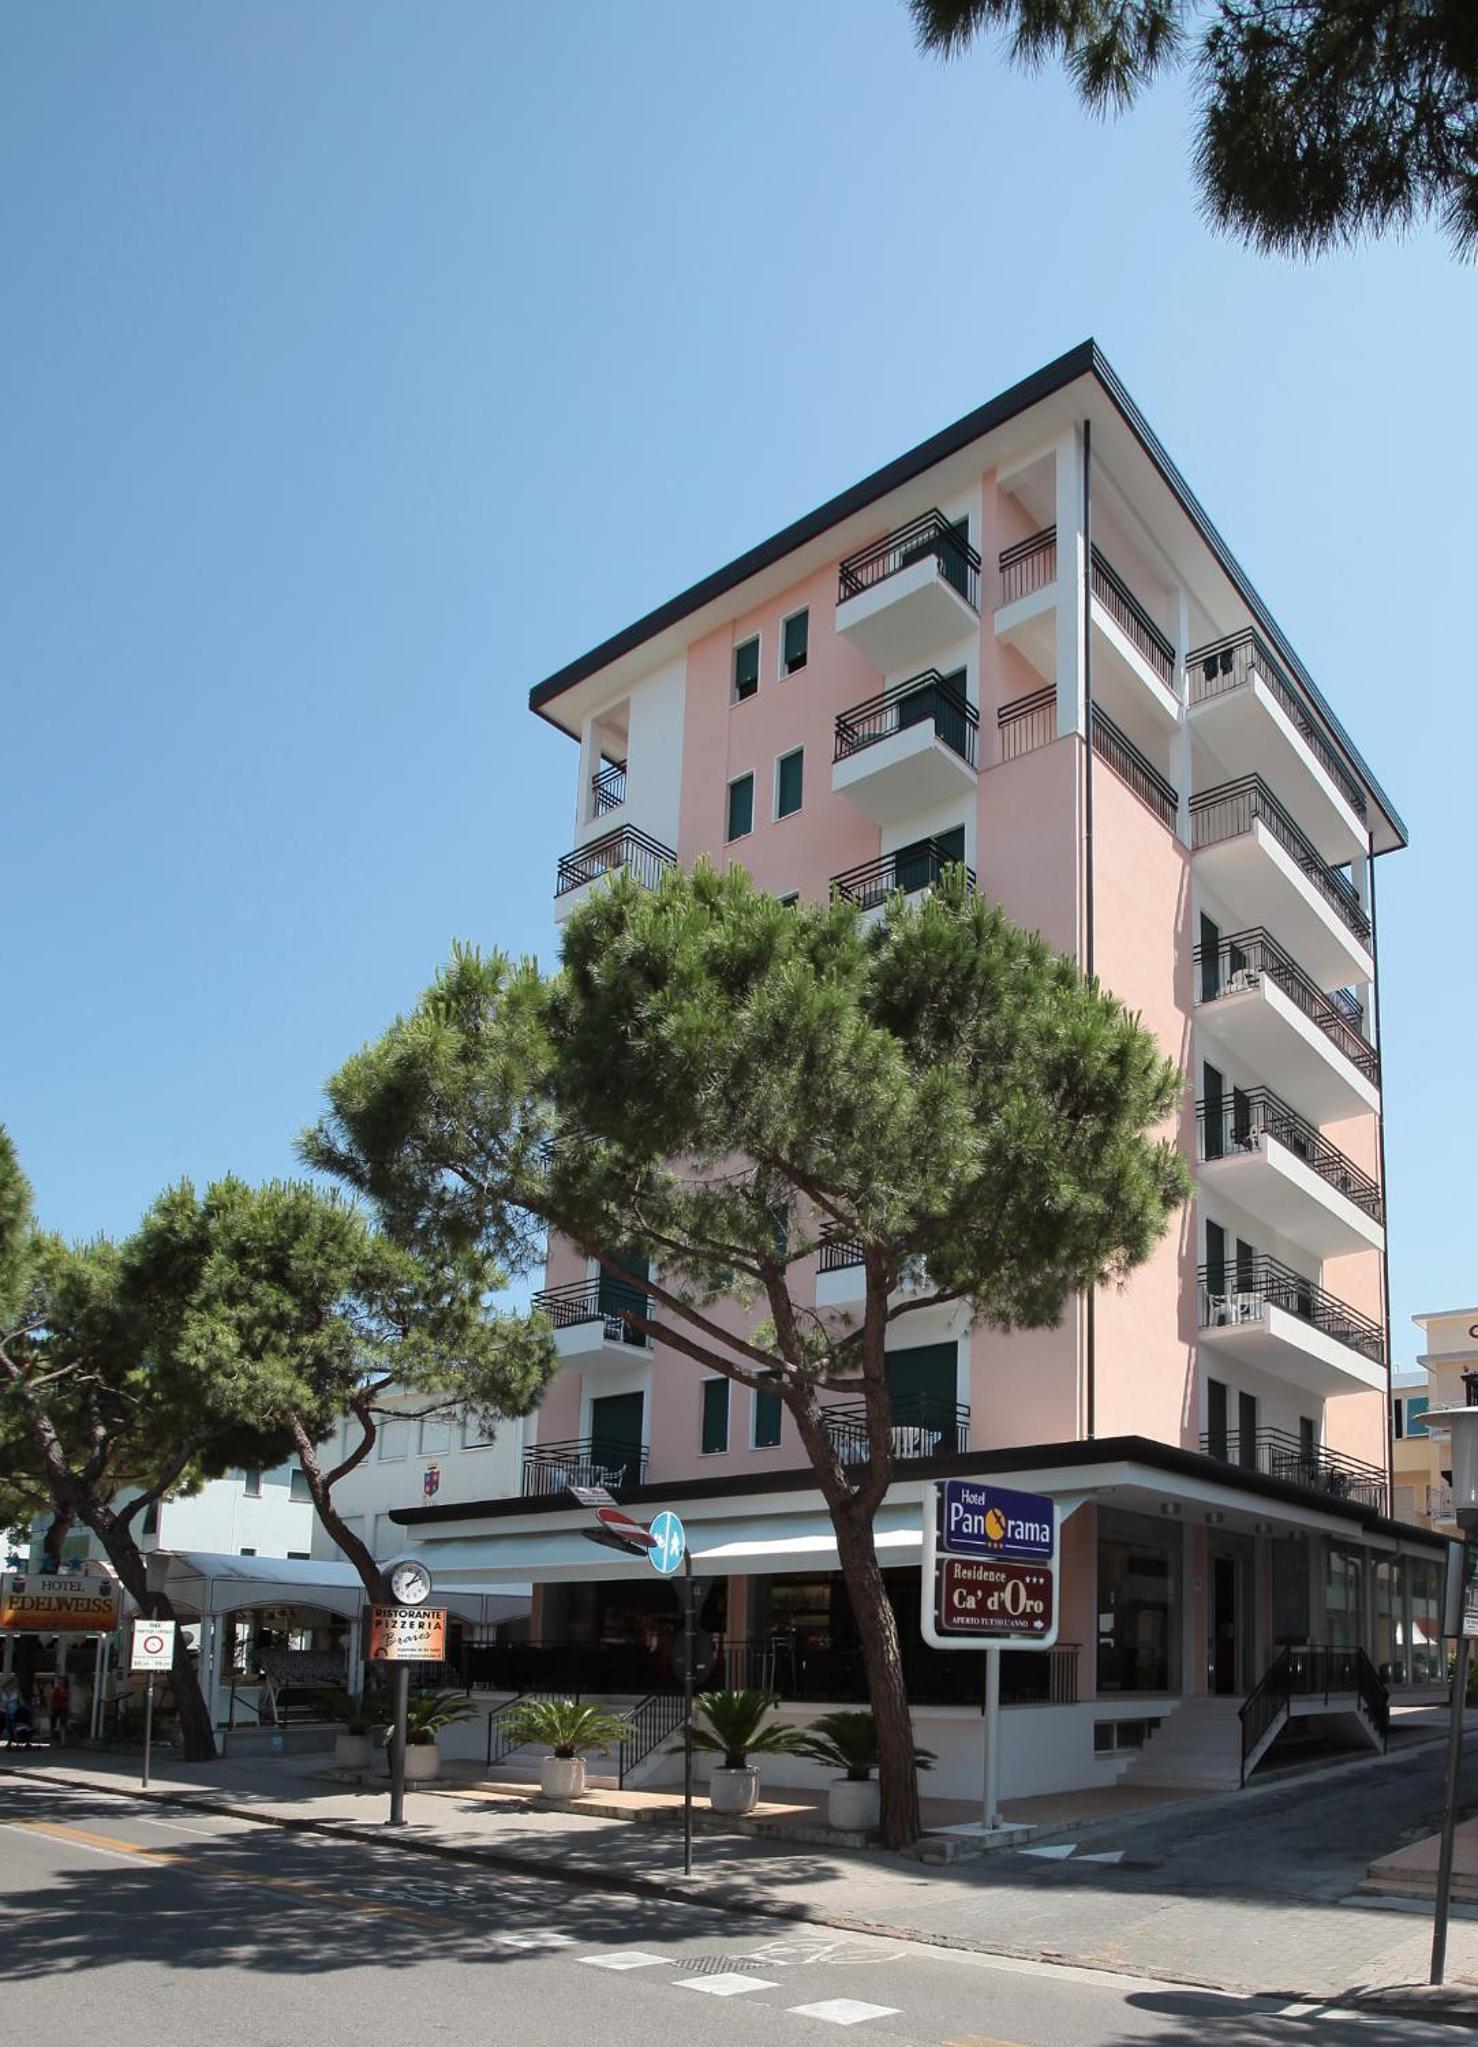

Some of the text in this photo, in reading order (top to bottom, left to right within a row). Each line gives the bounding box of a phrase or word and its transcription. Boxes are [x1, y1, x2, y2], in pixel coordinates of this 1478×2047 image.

[961, 1488, 986, 1506] Hotel
[953, 1563, 1007, 1583] Residence
[41, 1580, 85, 1592] HOTEL
[8, 1595, 113, 1613] EDELWEISS
[952, 1579, 1044, 1616] Ca' d'Oro
[375, 1609, 442, 1620] RISTORANTE
[952, 1616, 1029, 1628] APERTO TUTTO L'ANNO
[375, 1620, 442, 1631] PIZZERIA
